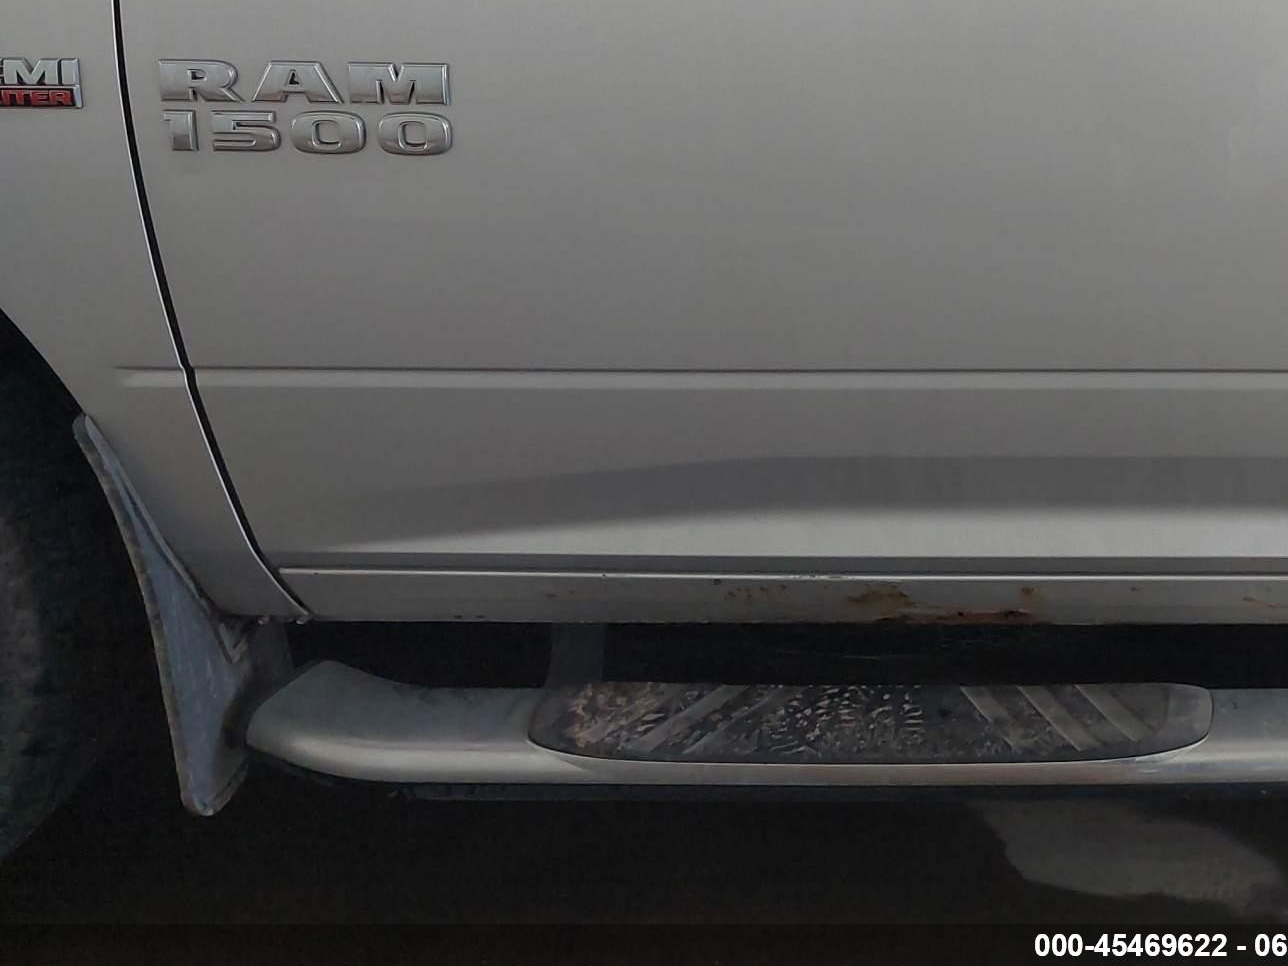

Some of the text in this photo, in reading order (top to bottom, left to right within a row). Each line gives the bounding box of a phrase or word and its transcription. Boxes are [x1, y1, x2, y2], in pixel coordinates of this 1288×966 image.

[0, 58, 80, 86] MI
[158, 58, 450, 106] RAM
[162, 109, 453, 156] 1500
